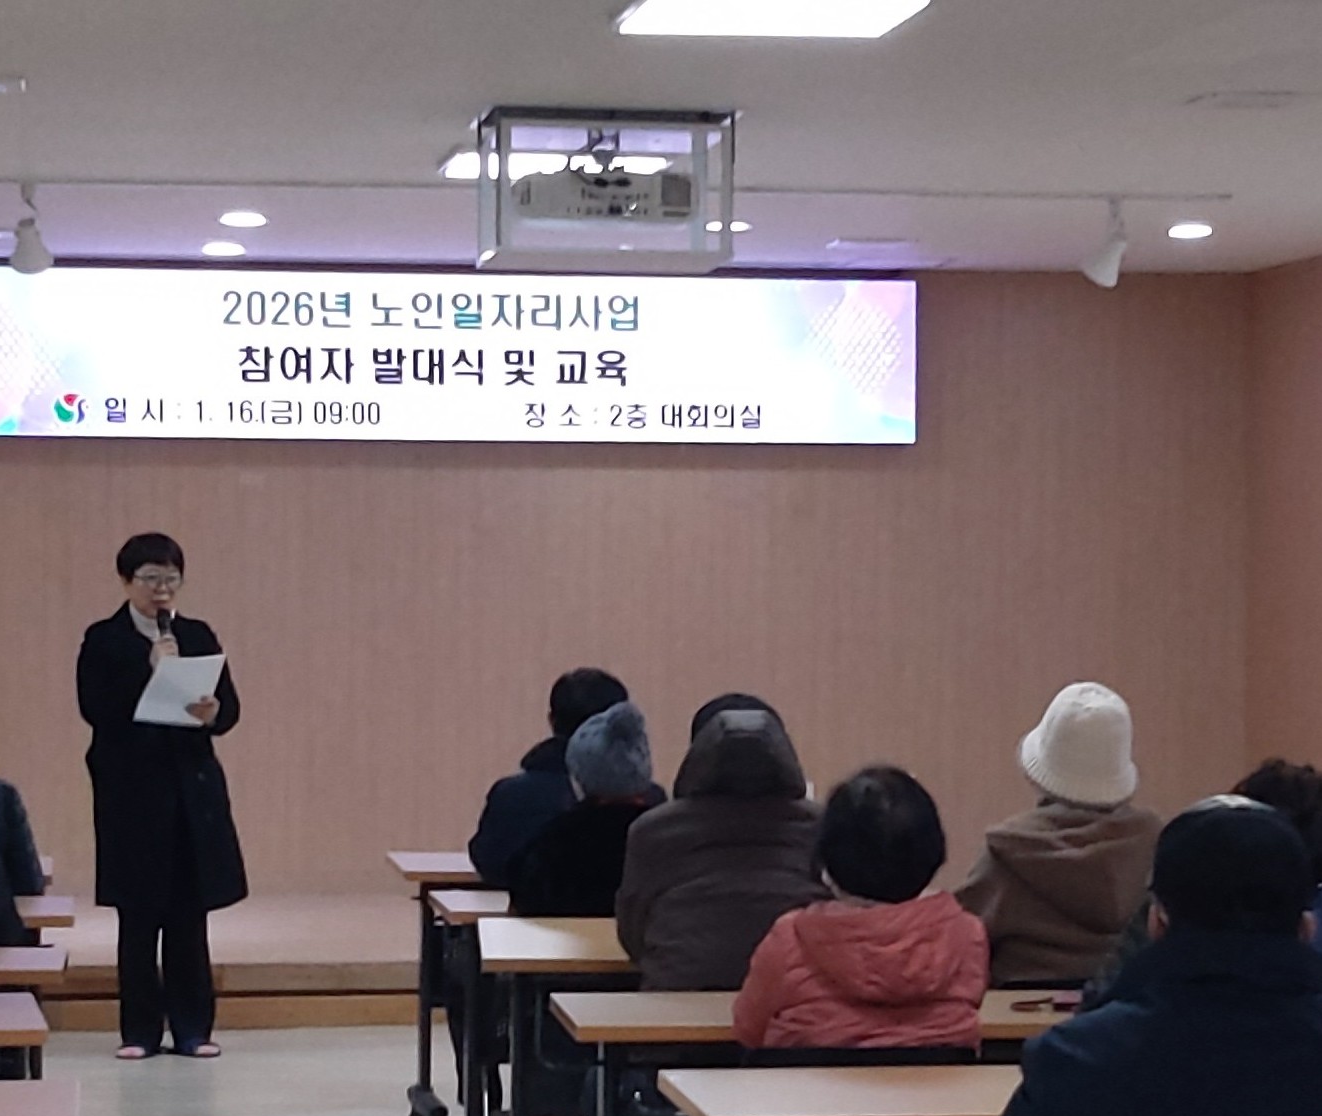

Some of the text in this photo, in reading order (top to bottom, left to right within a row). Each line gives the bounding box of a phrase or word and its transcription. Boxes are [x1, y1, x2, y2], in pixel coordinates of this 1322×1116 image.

[223, 290, 639, 332] 2026년 노인일자리사업
[238, 345, 628, 387] 참여자 발대식 및 교육
[313, 401, 381, 425] 09:00
[609, 404, 647, 429] 2층
[661, 404, 761, 429] 대회의실
